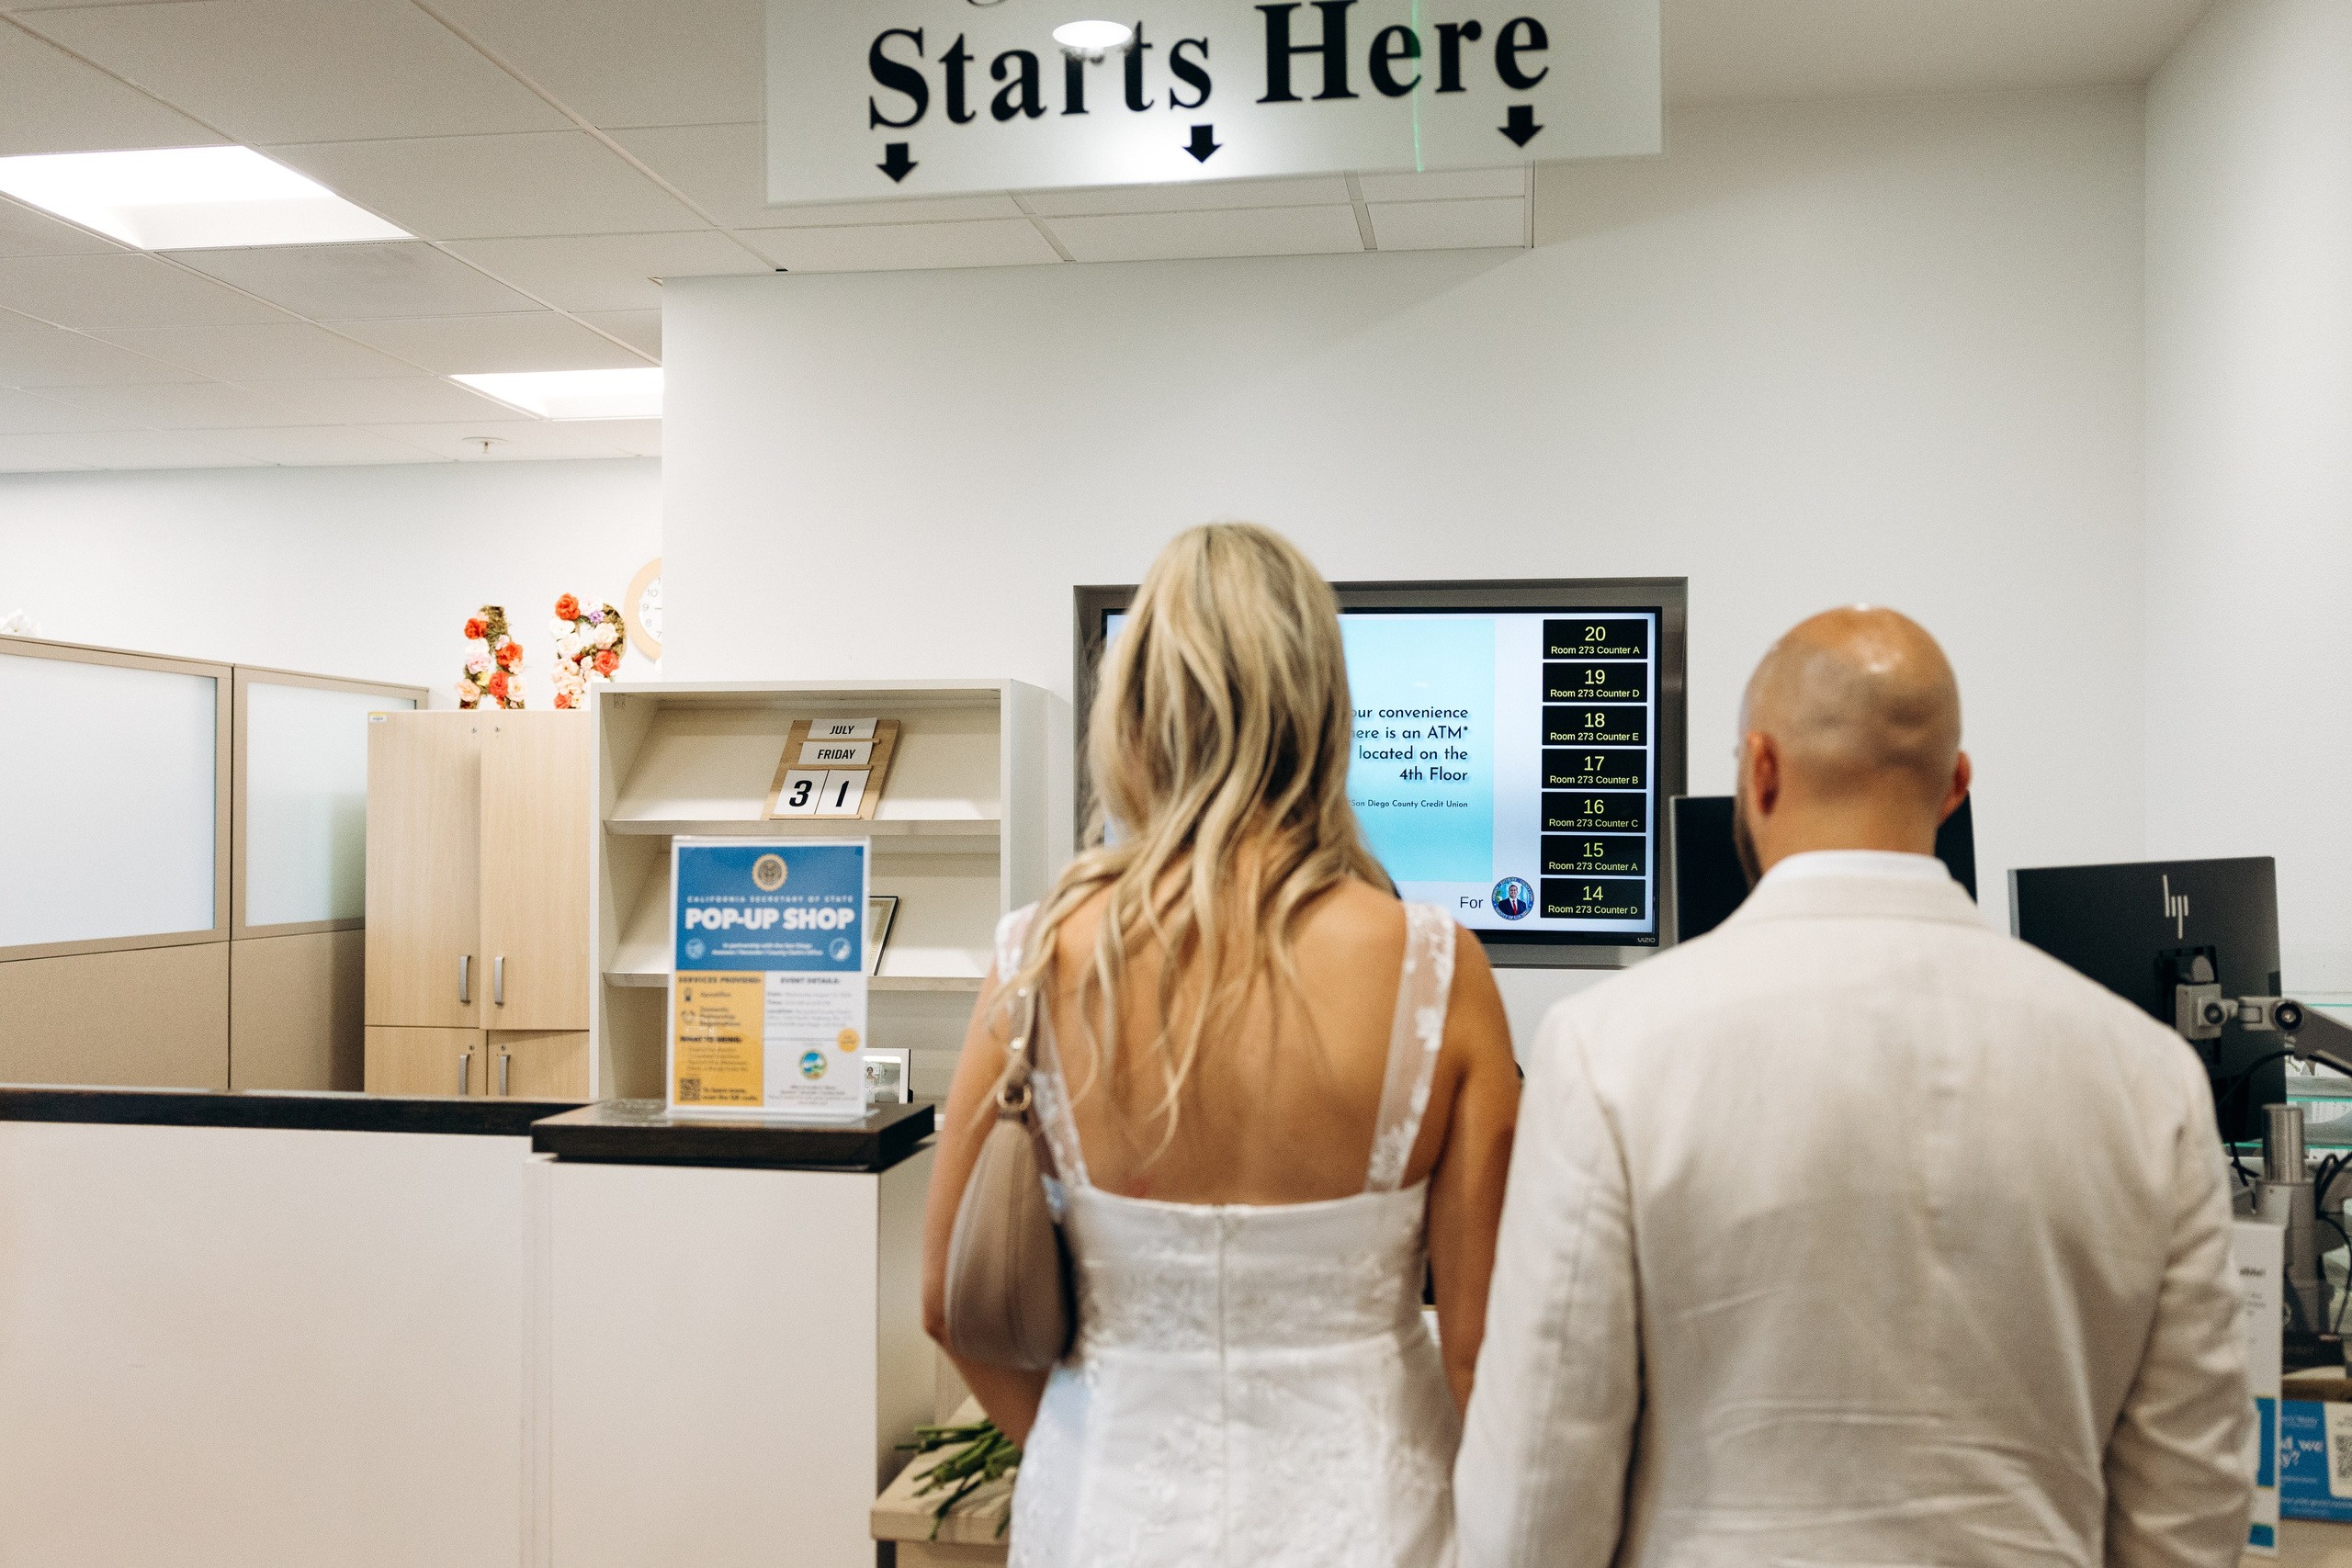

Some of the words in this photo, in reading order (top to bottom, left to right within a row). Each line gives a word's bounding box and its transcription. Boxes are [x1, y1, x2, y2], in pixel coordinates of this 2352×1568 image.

[868, 20, 1212, 130] Starts
[1254, 0, 1550, 104] Here
[1585, 626, 1606, 641] 20
[1551, 646, 1577, 655] Room
[1578, 646, 1595, 655] 273
[1597, 646, 1631, 655] Counter
[1633, 646, 1641, 655] A
[1585, 670, 1606, 684] 19
[1550, 689, 1576, 698] Room
[1577, 689, 1594, 698] 273
[1596, 689, 1630, 698] Counter
[1632, 689, 1640, 698] D
[1378, 706, 1468, 718] convenience
[1585, 713, 1605, 728] 18
[830, 725, 854, 735] JULY
[1385, 727, 1396, 739] is
[1402, 730, 1420, 739] an
[1550, 732, 1576, 741] Room
[1577, 732, 1594, 741] 273
[1596, 732, 1630, 741] Counter
[1632, 732, 1639, 741] E
[817, 749, 856, 760] FRIDAY
[1359, 745, 1414, 760] located
[1419, 750, 1438, 760] on
[1444, 745, 1468, 760] the
[1585, 756, 1605, 771] 17
[1399, 766, 1423, 781] 4th
[1430, 766, 1468, 781] Floor
[1550, 775, 1575, 784] Room
[1577, 775, 1593, 784] 273
[1595, 776, 1629, 784] Counter
[1632, 776, 1639, 784] B
[789, 780, 813, 807] 3
[1367, 799, 1390, 808] Diego
[1392, 800, 1419, 809] County
[1420, 800, 1443, 808] Credit
[1446, 800, 1468, 808] Union
[1584, 799, 1604, 815] 16
[1549, 818, 1575, 828] Room
[1577, 818, 1593, 828] 273
[1595, 819, 1629, 828] Counter
[1631, 819, 1638, 828] C
[1584, 842, 1604, 858] 15
[1549, 862, 1574, 871] Room
[1577, 862, 1592, 871] 273
[1594, 863, 1629, 871] Counter
[1631, 863, 1638, 871] A
[1583, 886, 1603, 901] 14
[1460, 896, 1484, 909] For
[2163, 874, 2188, 939] hp
[1548, 905, 1574, 914] Room
[1576, 905, 1592, 914] 273
[1594, 906, 1628, 915] Counter
[1631, 906, 1638, 915] D
[685, 907, 780, 930] POP-UP
[782, 907, 855, 930] SHOP
